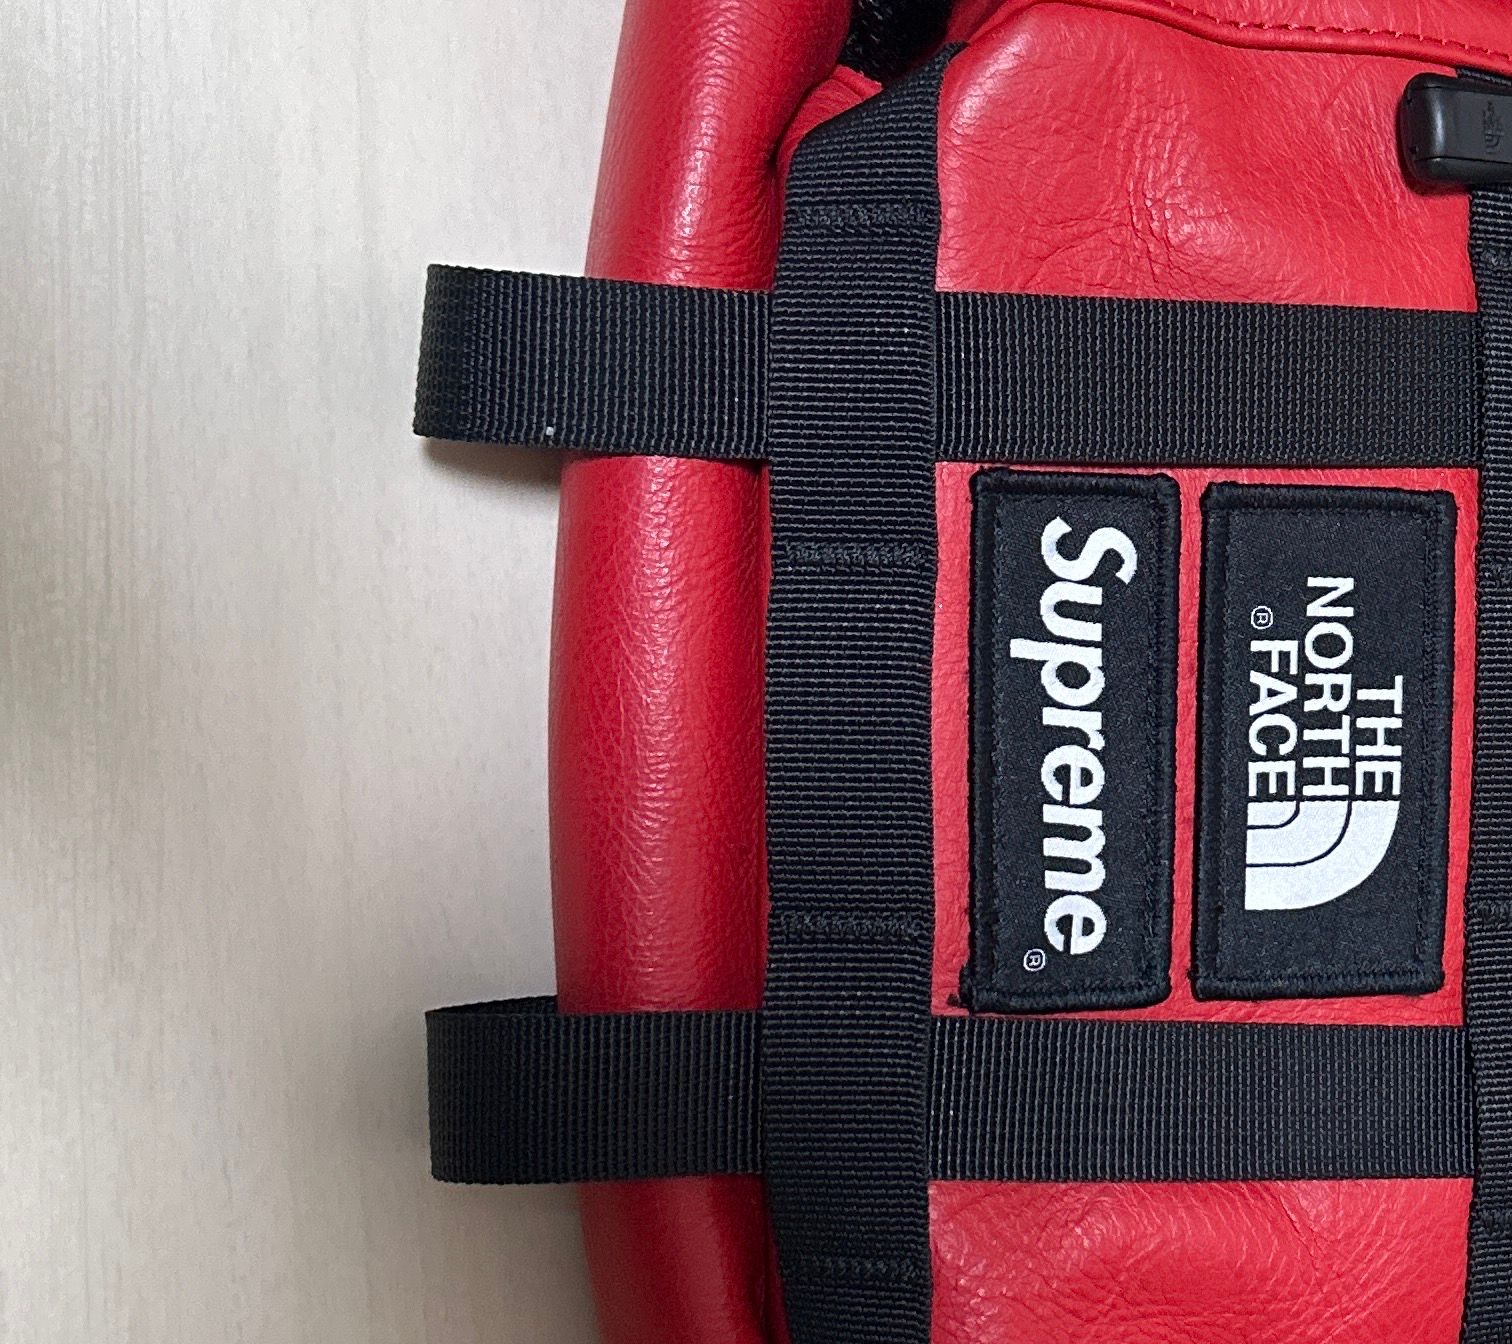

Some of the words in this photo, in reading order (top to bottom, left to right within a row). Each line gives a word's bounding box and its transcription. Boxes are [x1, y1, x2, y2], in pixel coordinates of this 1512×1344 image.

[1010, 517, 1138, 955] Supreme
[1249, 639, 1299, 798] FACE
[1302, 576, 1355, 798] NORTH
[1356, 675, 1403, 796] THE
